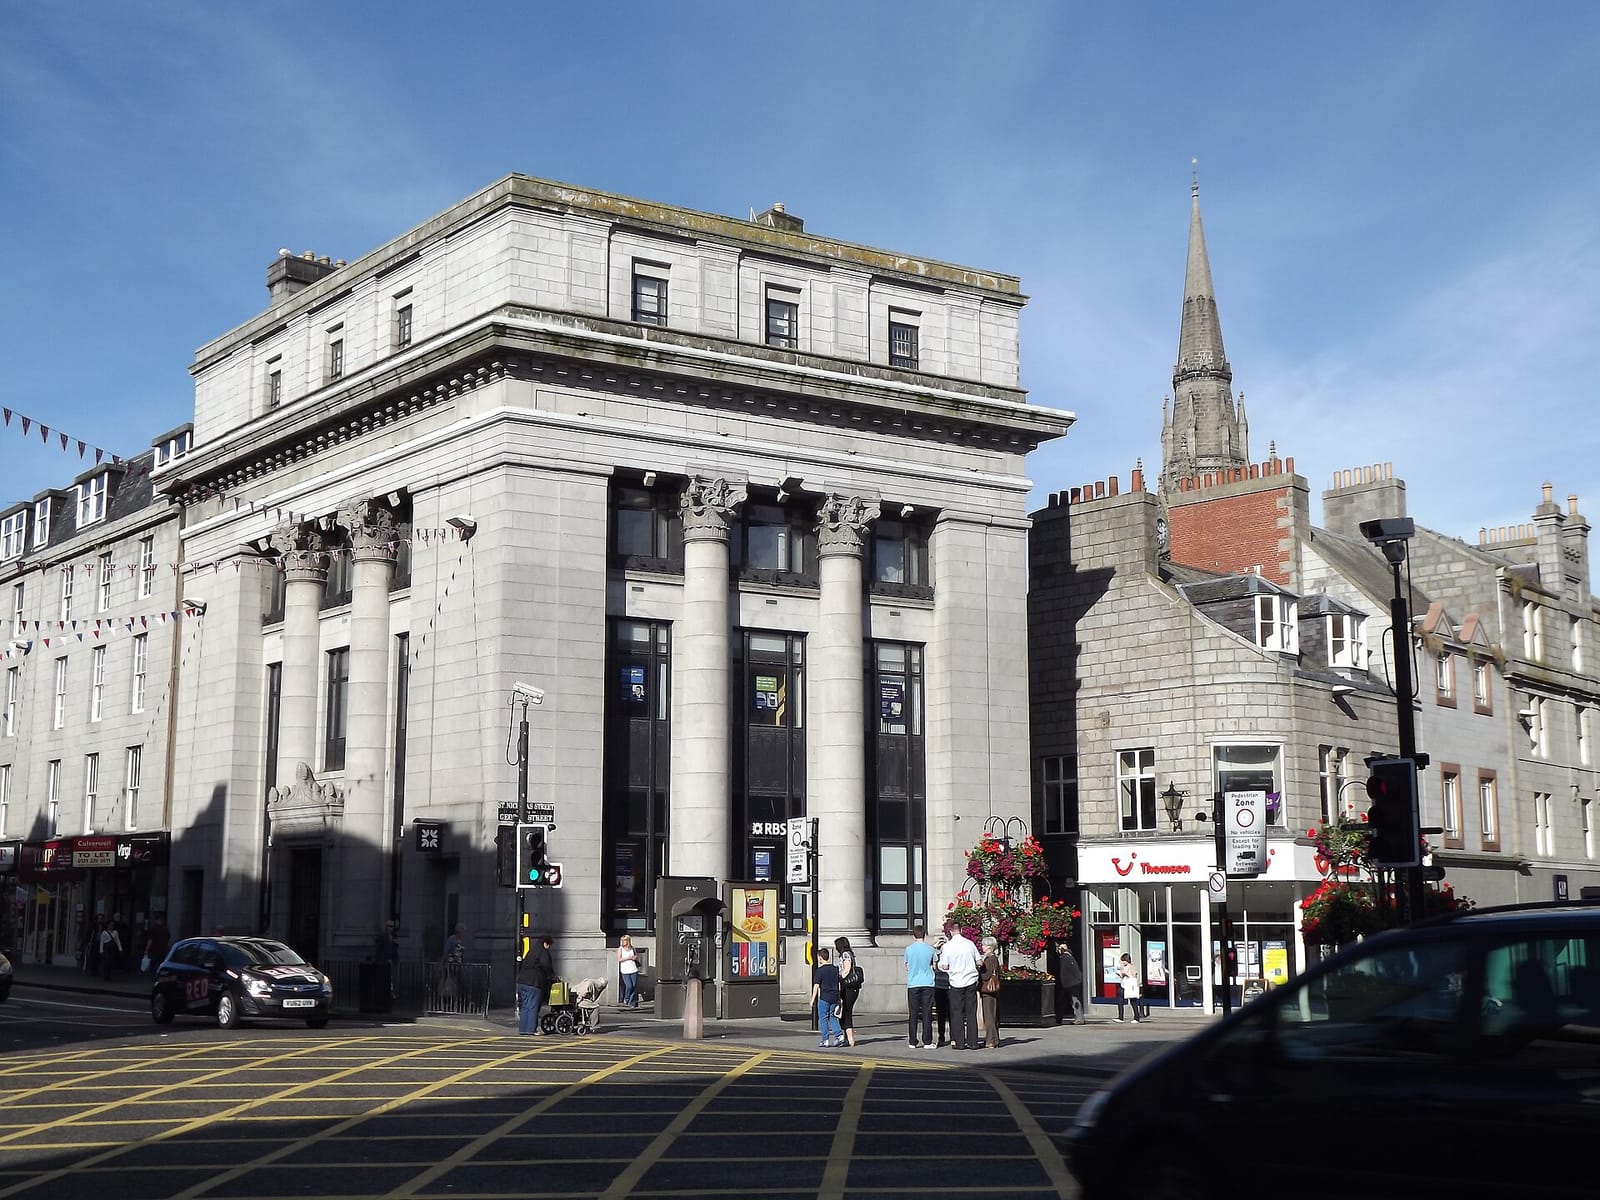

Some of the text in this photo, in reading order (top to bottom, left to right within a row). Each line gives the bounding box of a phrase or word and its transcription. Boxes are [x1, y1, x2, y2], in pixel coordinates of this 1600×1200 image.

[764, 822, 787, 836] RBS
[1140, 862, 1191, 875] Thomson
[186, 977, 209, 1001] RED
